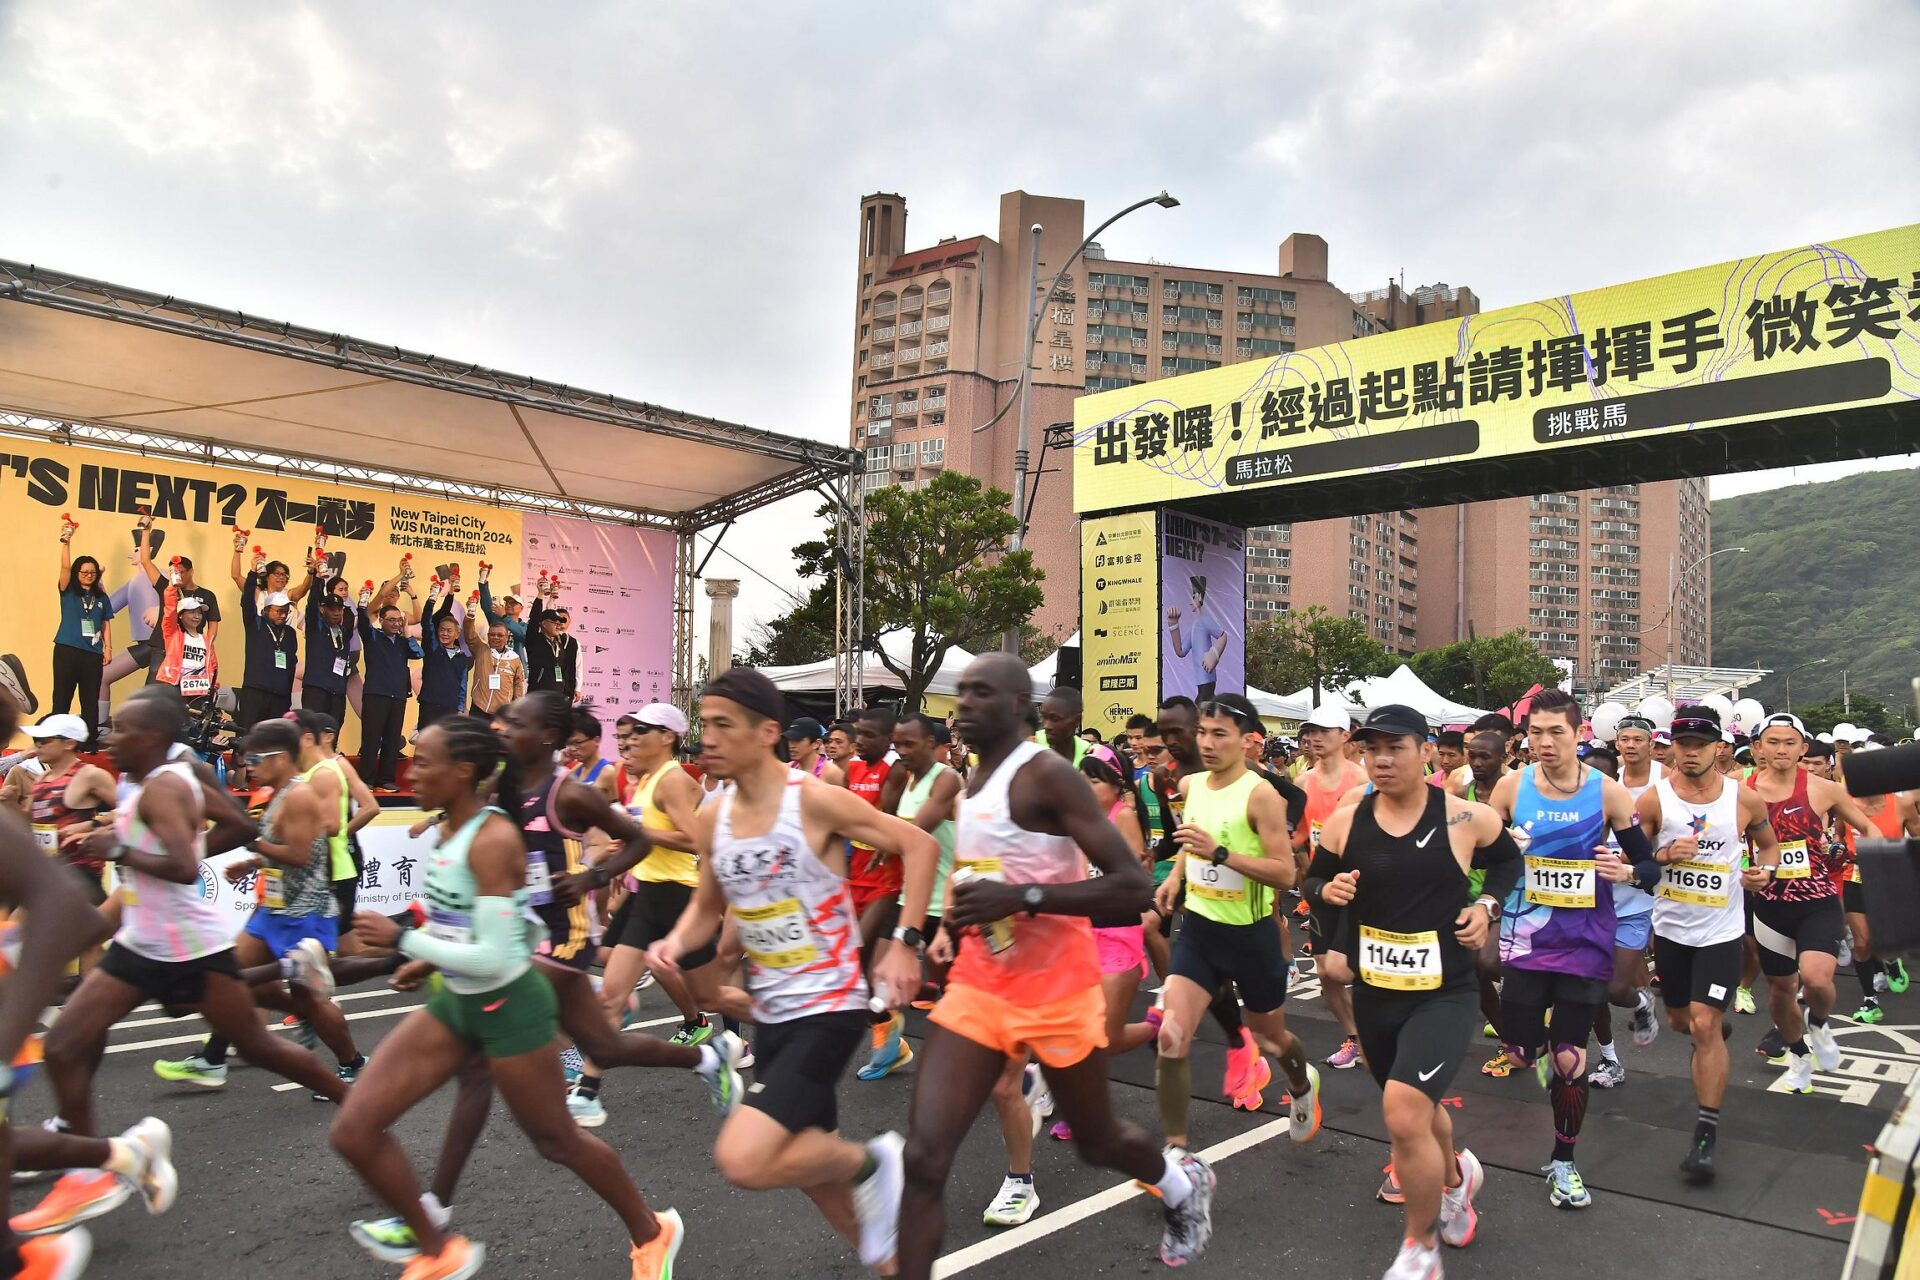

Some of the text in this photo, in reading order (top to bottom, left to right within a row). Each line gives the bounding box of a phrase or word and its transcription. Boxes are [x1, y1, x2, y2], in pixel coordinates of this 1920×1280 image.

[1049, 305, 1075, 374] 摘星樓
[1094, 308, 1725, 466] 出發囉！經過起點請揮揮手
[1547, 402, 1628, 437] 挑戰馬
[1234, 453, 1294, 480] 馬拉松
[78, 464, 248, 525] NEXT?
[391, 506, 486, 531] New Taipei City
[390, 519, 513, 544] WJS Marathon 2024
[390, 533, 487, 555] 新北市萬金石馬拉松
[1109, 707, 1134, 716] HERMES
[1201, 869, 1219, 883] LO
[1533, 869, 1585, 889] 11137
[1665, 868, 1722, 890] 11669
[392, 892, 402, 901] of
[1529, 892, 1538, 902] A
[1663, 887, 1672, 898] A
[234, 901, 258, 913] Spo
[1367, 944, 1430, 969] 11447
